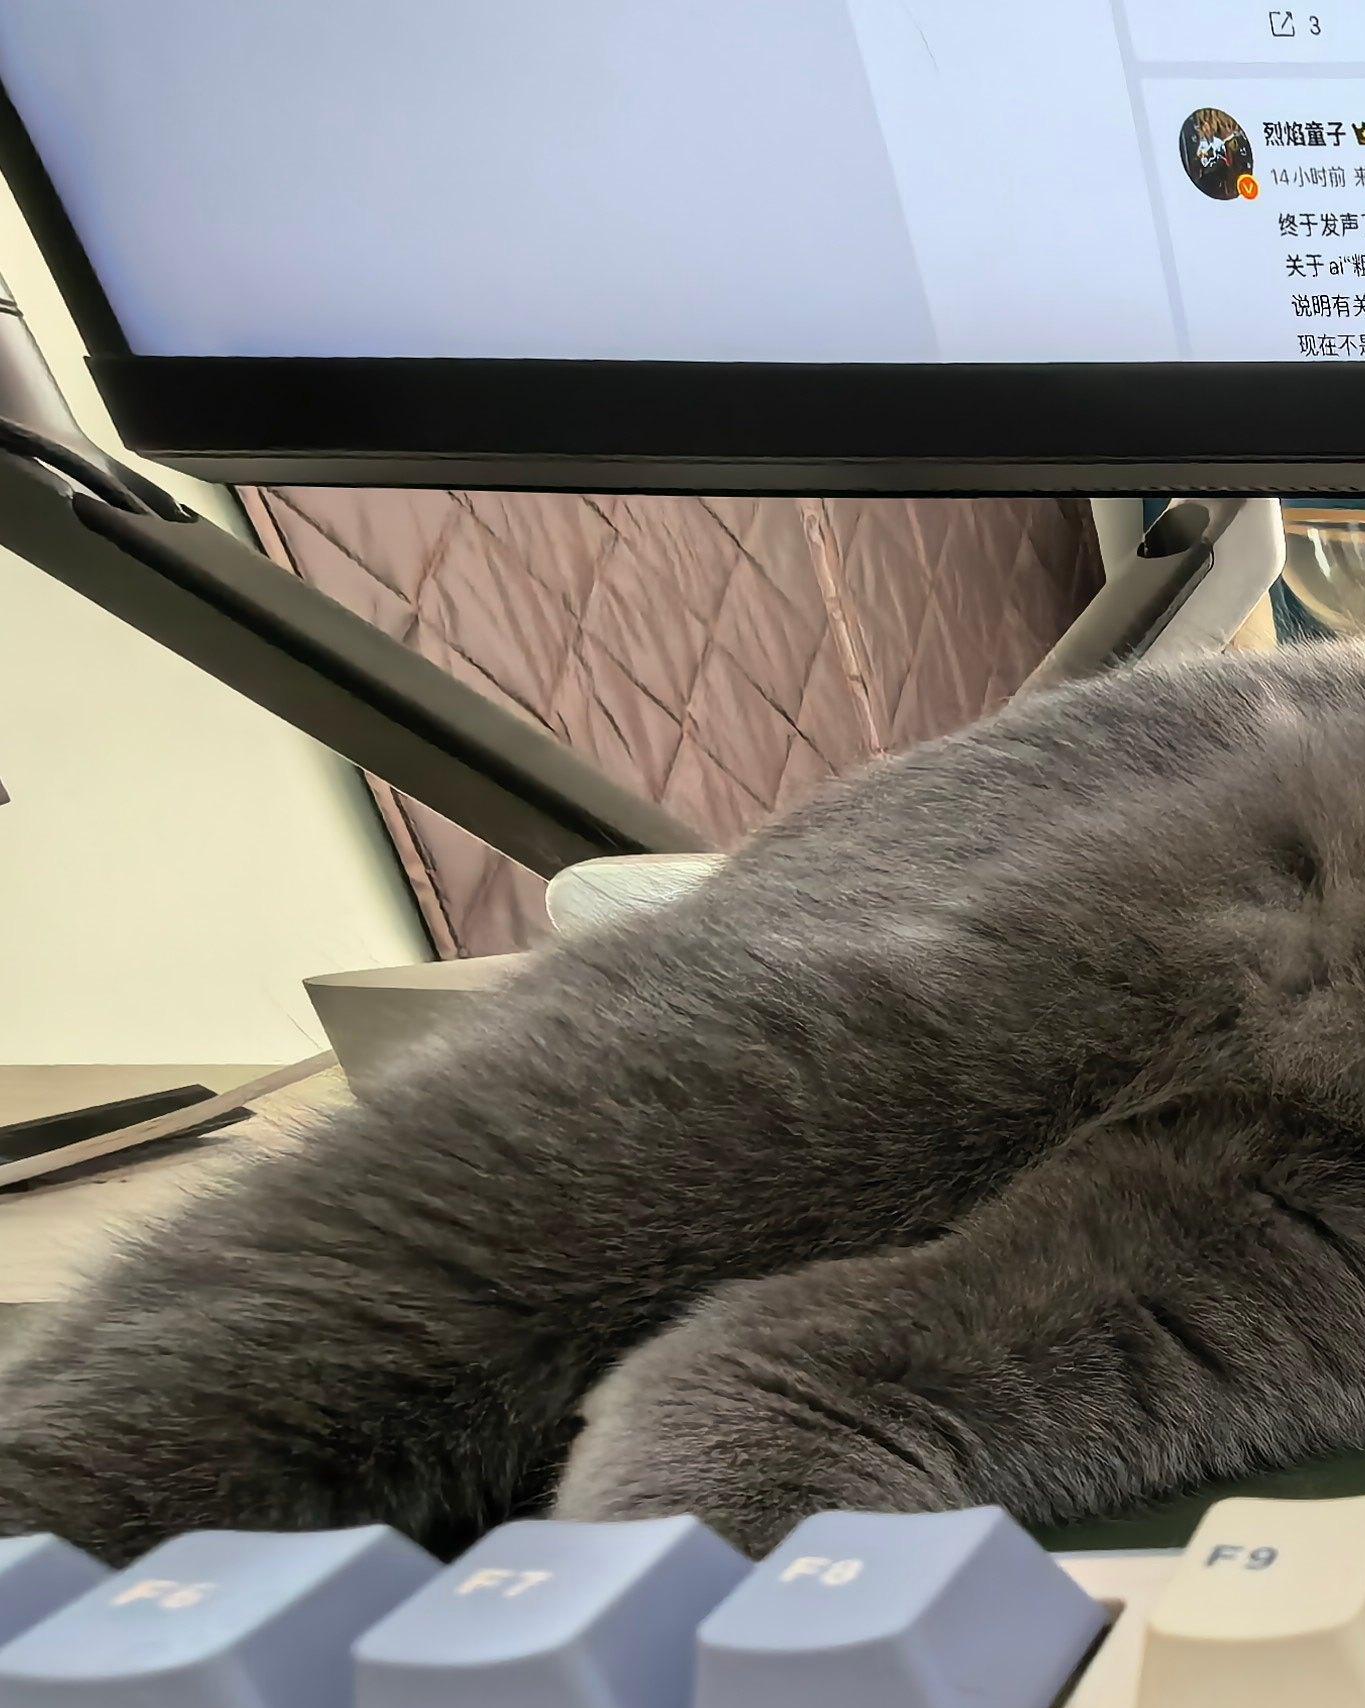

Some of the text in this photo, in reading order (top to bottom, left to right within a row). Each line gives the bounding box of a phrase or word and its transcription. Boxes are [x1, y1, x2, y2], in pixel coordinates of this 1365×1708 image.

[1309, 15, 1321, 36] 3
[1263, 121, 1346, 147] 烈焰童子
[1204, 1542, 1279, 1572] F9
[455, 1568, 553, 1597] F7
